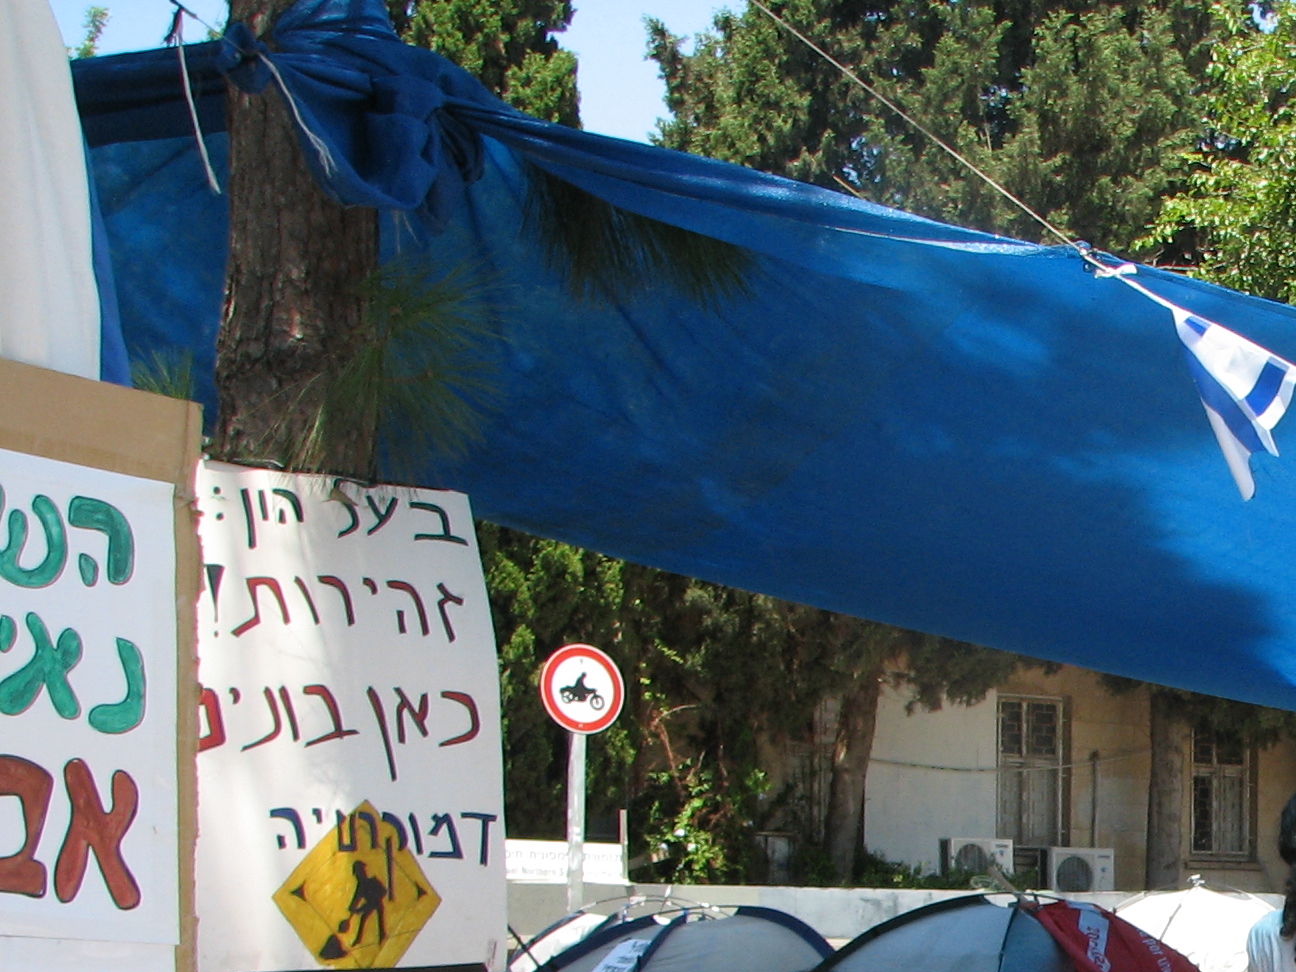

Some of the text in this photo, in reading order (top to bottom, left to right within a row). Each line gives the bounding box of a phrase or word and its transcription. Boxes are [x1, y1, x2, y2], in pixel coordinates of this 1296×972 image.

[333, 480, 468, 546] בעל
[366, 686, 480, 782] כאן
[269, 806, 498, 902] דמוקרטיה
